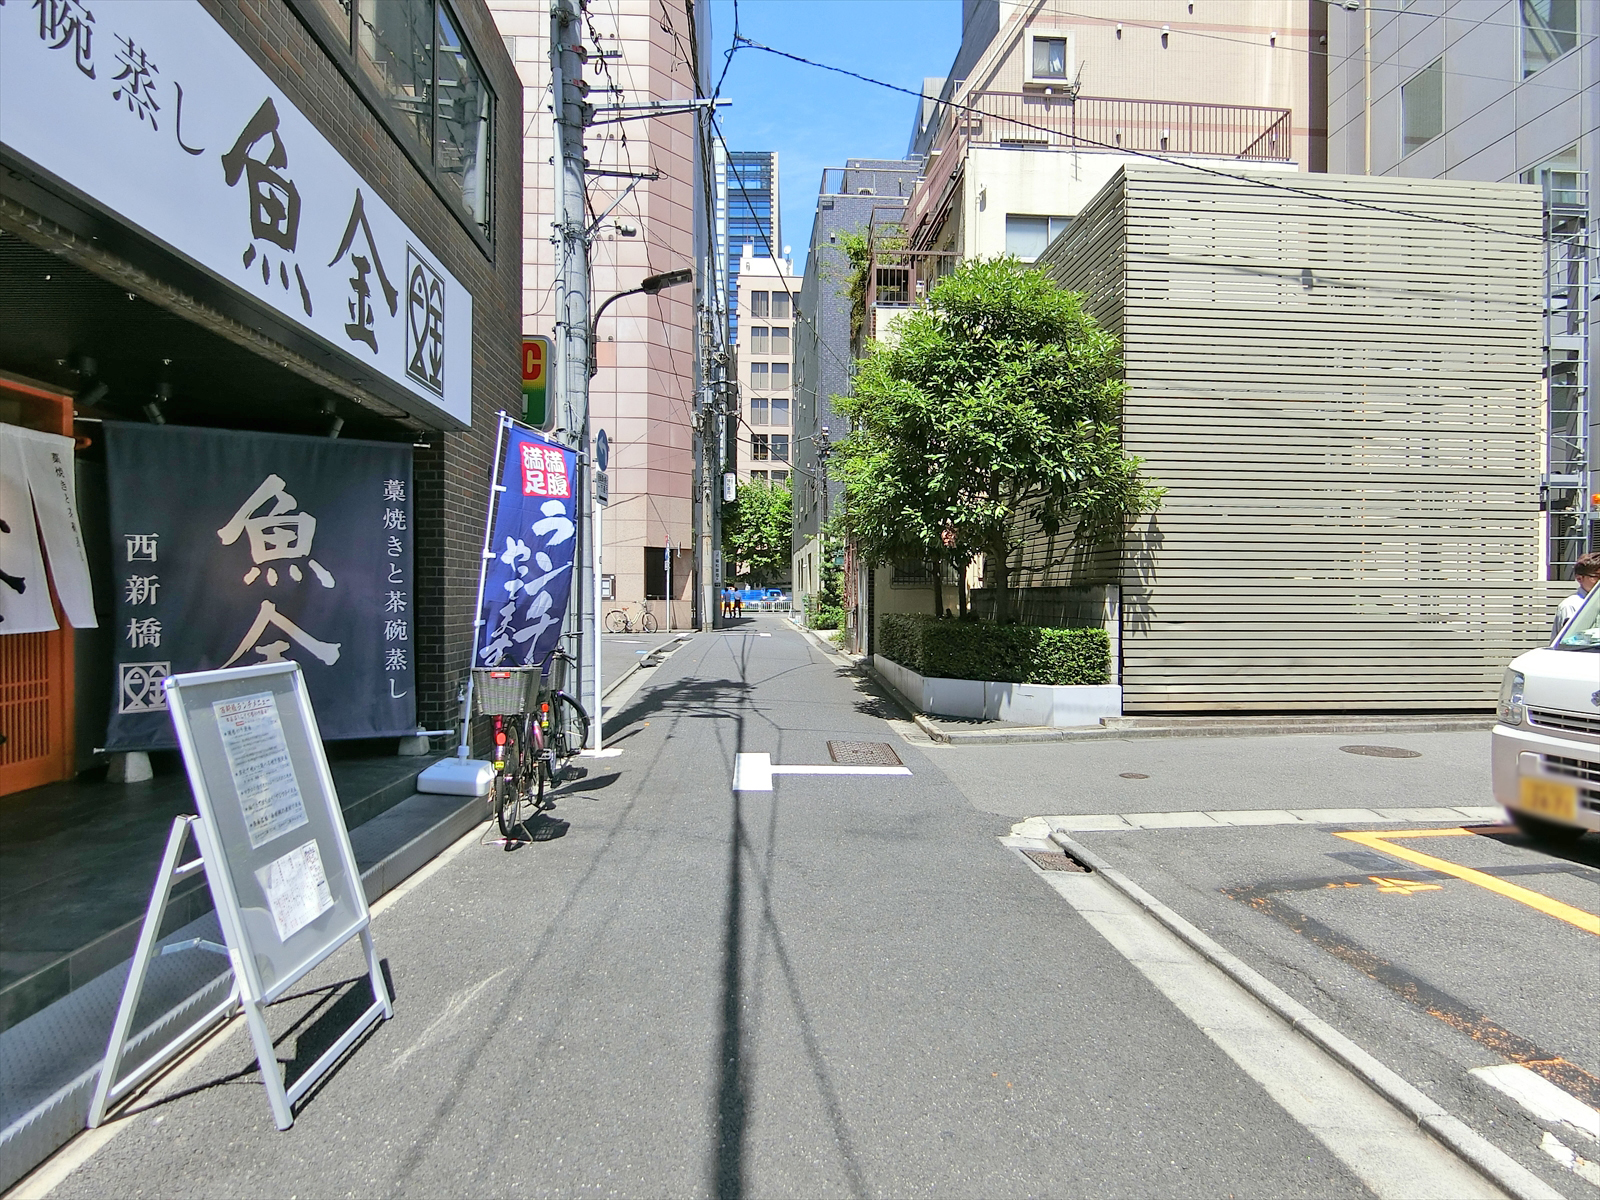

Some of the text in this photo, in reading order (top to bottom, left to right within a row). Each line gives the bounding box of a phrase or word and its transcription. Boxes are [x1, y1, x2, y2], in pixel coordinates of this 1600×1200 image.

[0, 0, 205, 155] 碗蒸し
[221, 97, 398, 355] 魚金
[523, 445, 547, 495] 満足
[543, 449, 568, 497] 満腹
[124, 533, 162, 648] 西新橋
[383, 479, 408, 699] 藁焼きと茶碗蒸し
